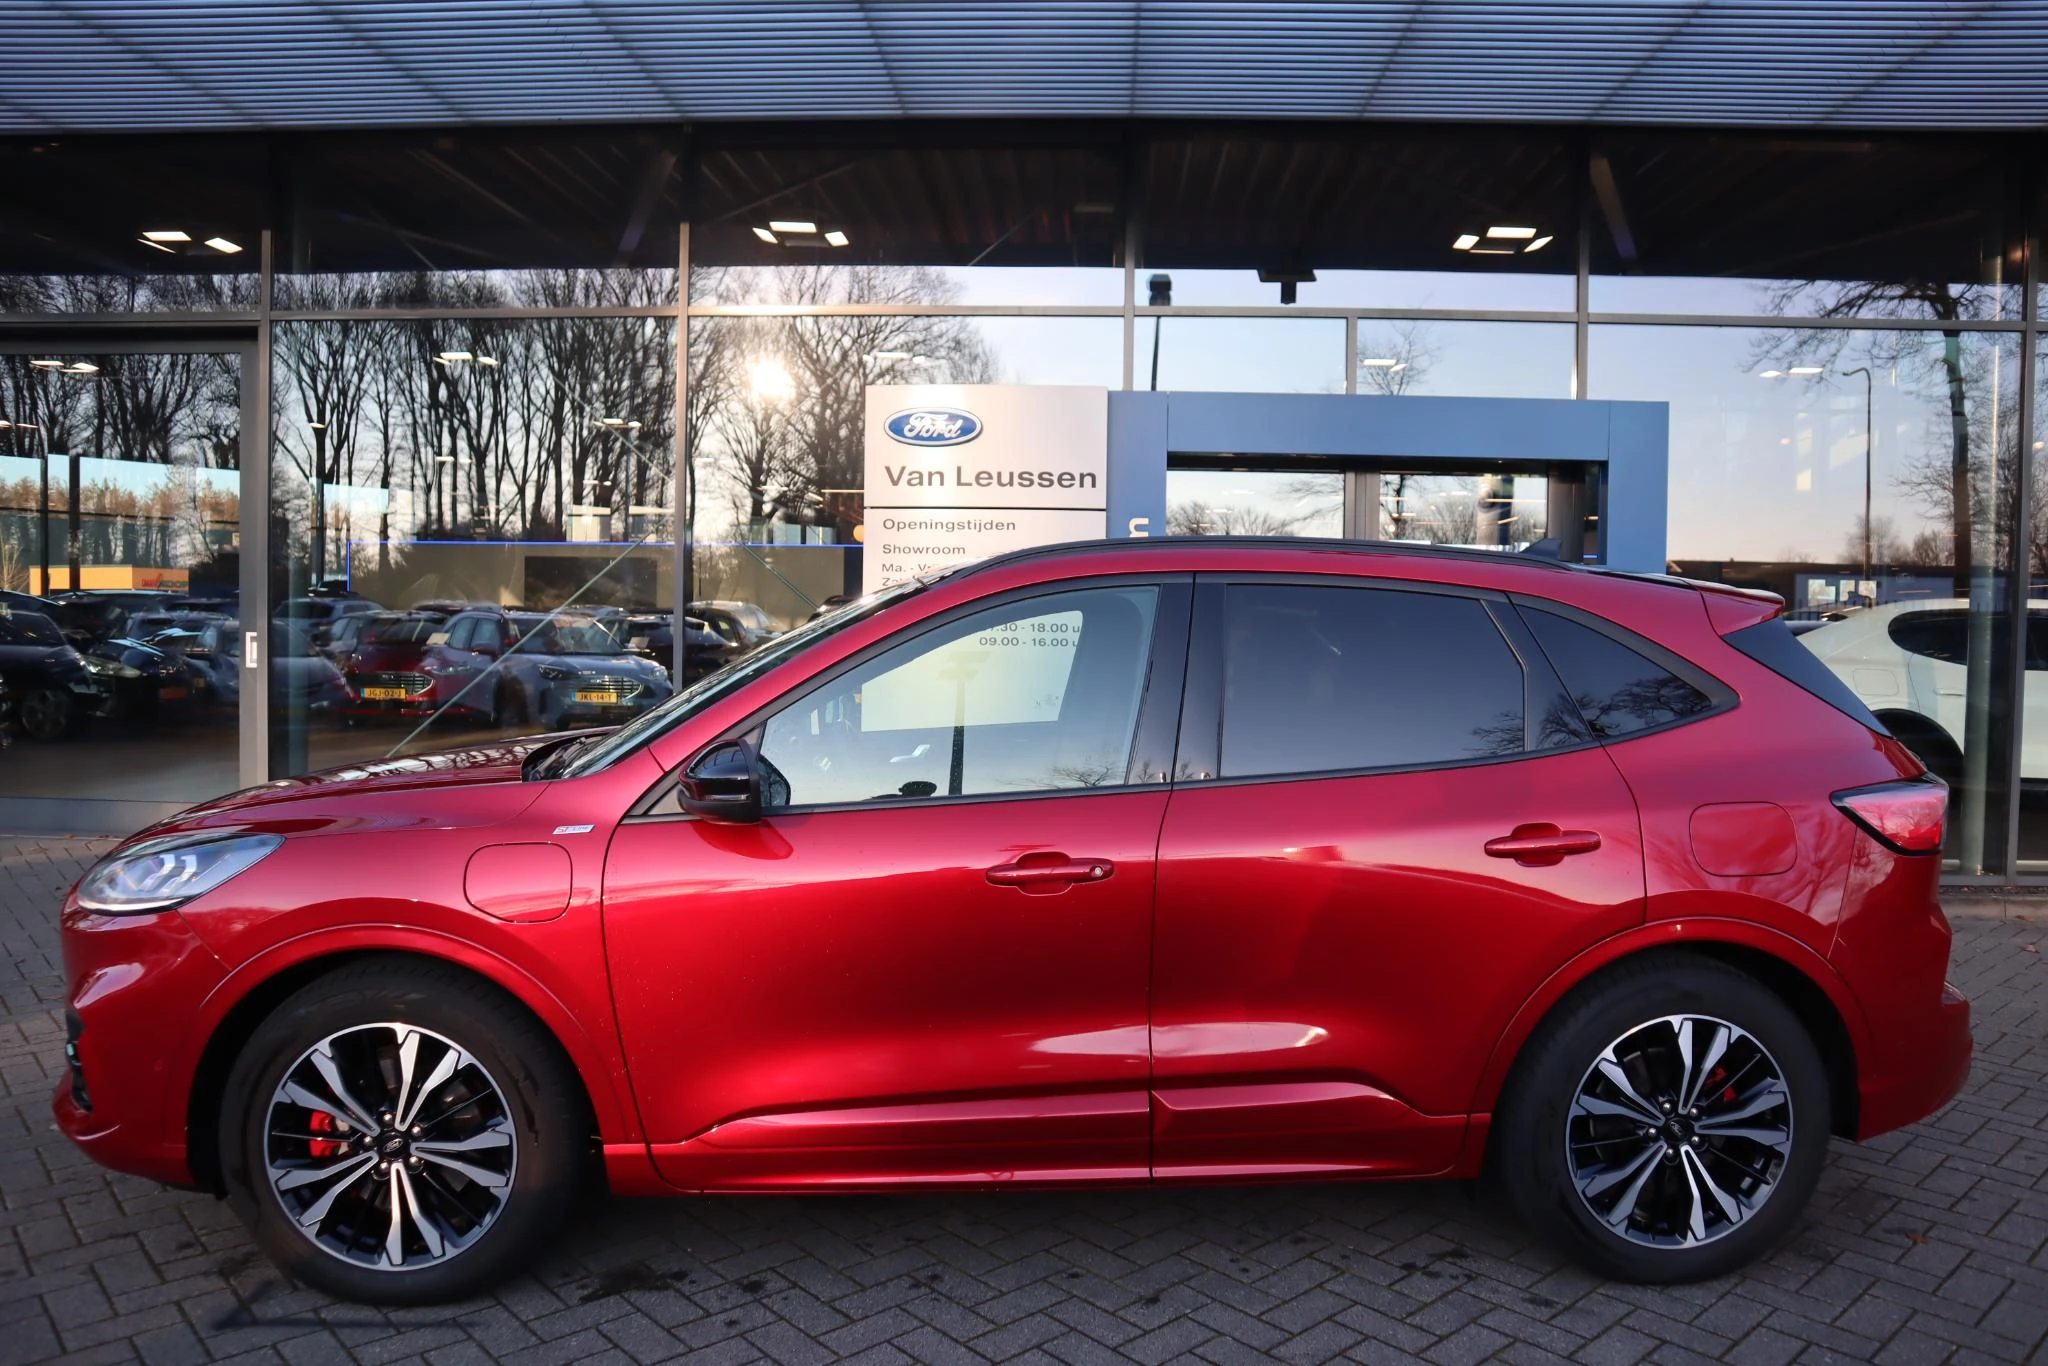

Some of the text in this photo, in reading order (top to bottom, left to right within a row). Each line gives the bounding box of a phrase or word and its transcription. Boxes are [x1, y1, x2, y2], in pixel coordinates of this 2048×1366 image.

[884, 465, 1097, 489] Van Leussen
[882, 518, 1016, 534] Openingstijden
[882, 543, 966, 556] Showroom
[881, 562, 907, 574] Ma.
[1030, 622, 1069, 634] 18.00
[979, 636, 1019, 647] 09.00
[1031, 636, 1069, 648] 16.00
